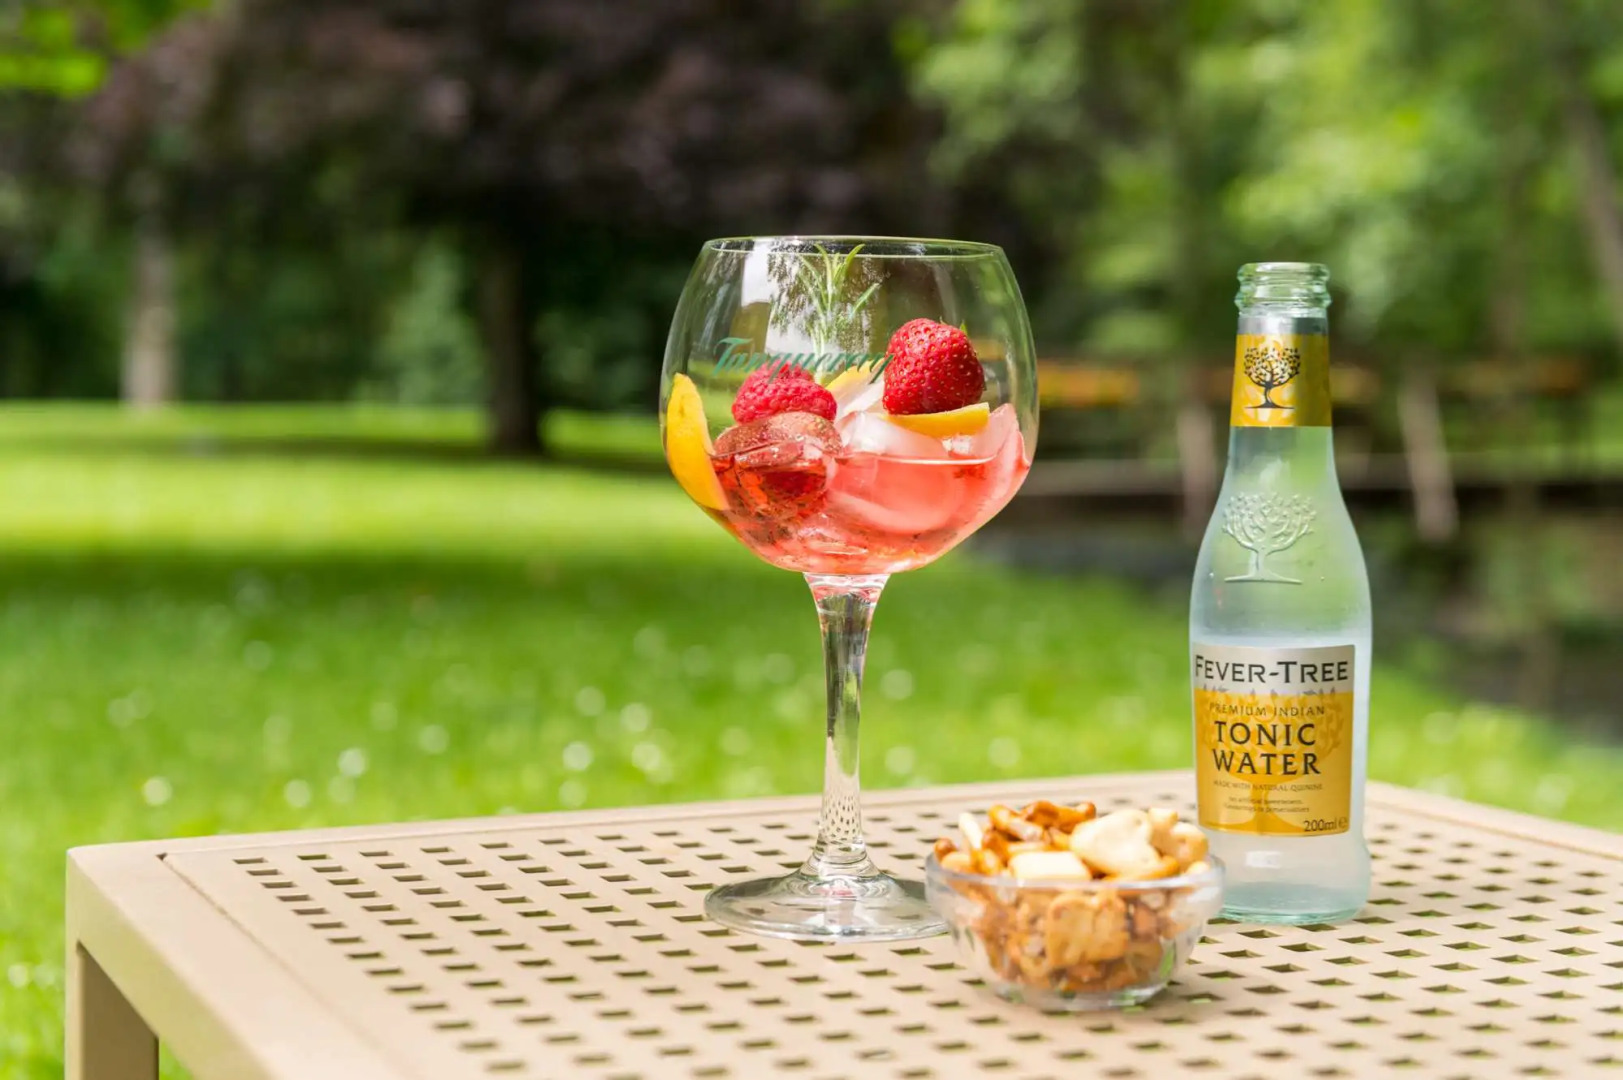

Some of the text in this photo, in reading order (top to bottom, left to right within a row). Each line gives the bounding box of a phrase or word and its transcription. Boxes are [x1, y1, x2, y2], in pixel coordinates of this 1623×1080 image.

[712, 336, 895, 385] Tanqueray
[1195, 654, 1349, 684] FEVER-TREE
[1209, 702, 1325, 717] PREMIUM INDIAN
[1214, 720, 1316, 747] TONIC
[1212, 748, 1321, 775] WATER
[1303, 817, 1337, 832] 200ml
